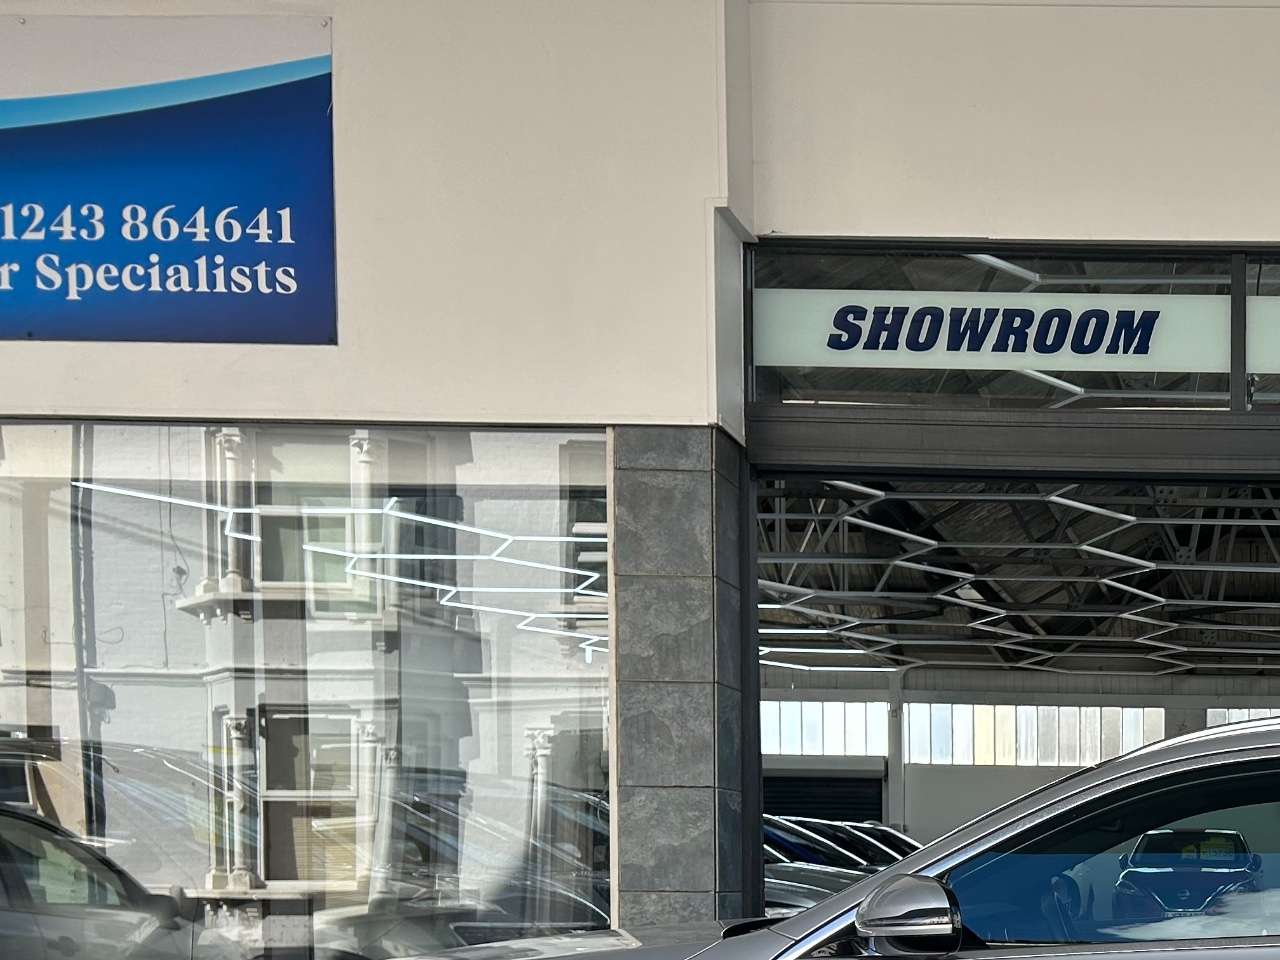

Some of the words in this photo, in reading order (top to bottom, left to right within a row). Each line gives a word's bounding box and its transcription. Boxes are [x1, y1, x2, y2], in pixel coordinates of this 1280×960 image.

[121, 204, 296, 244] 864641
[35, 253, 298, 301] Specialists
[826, 305, 1161, 355] SHOWROOM
